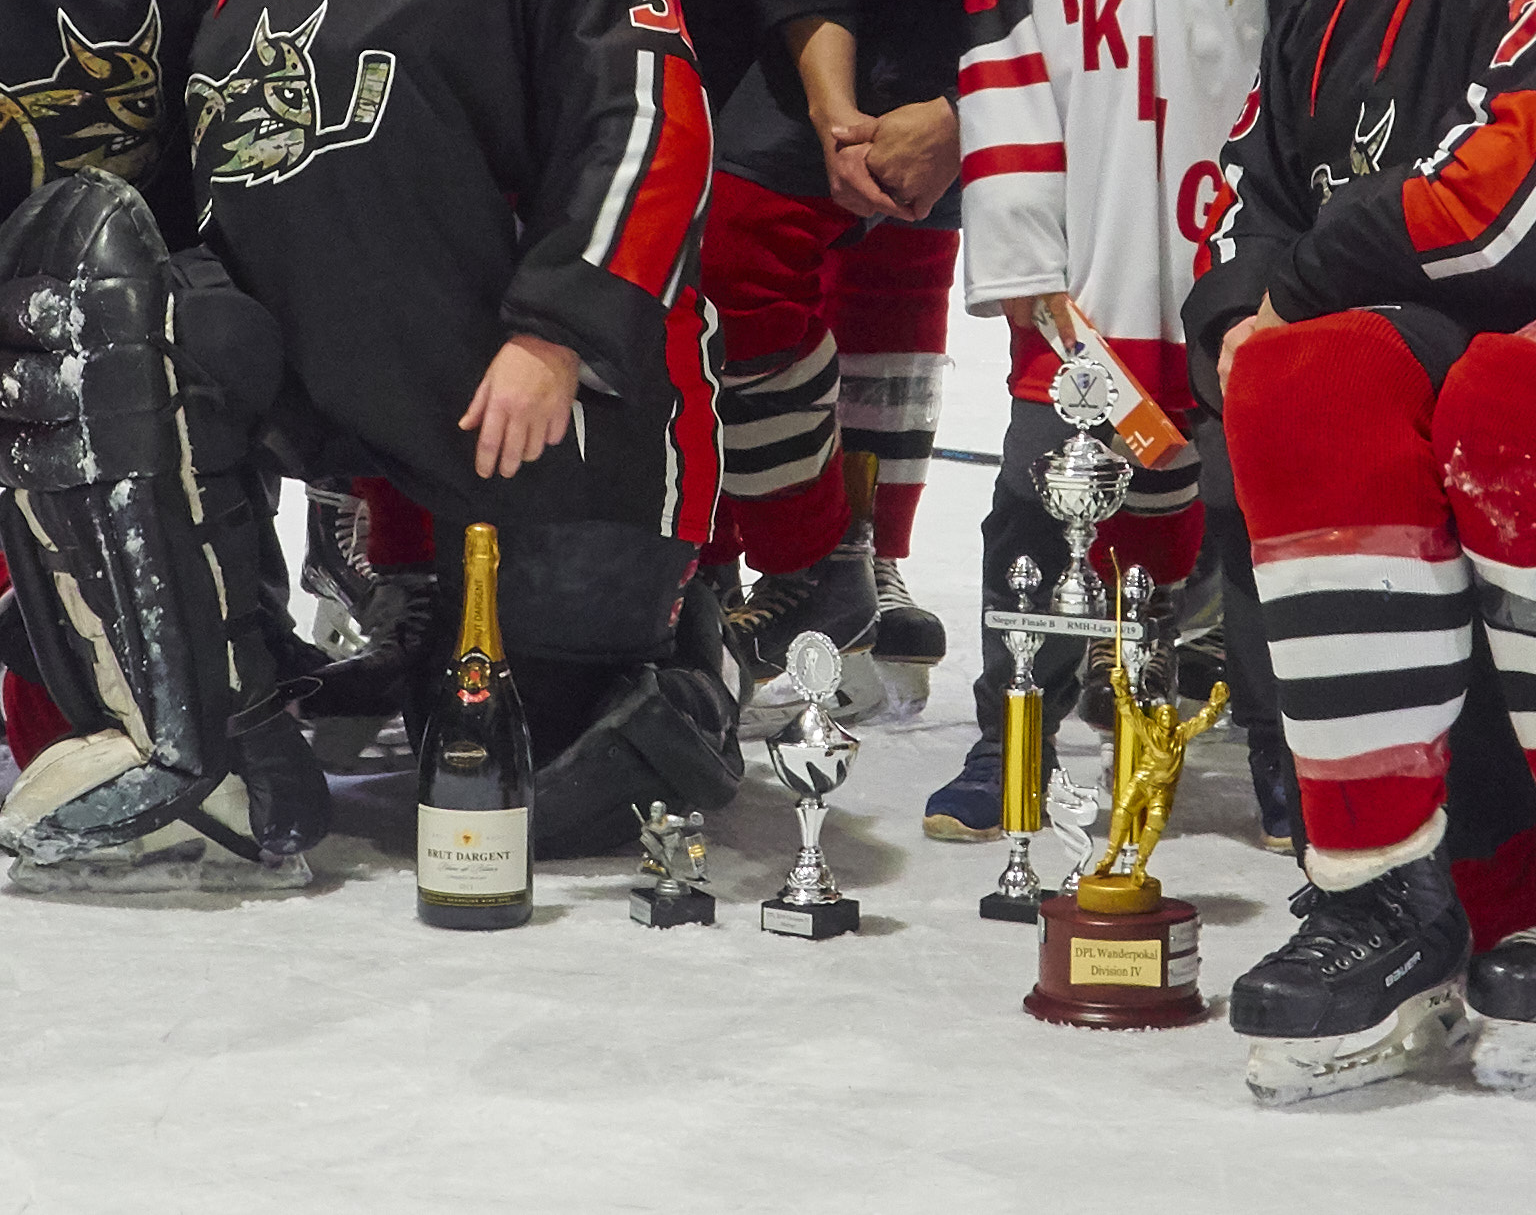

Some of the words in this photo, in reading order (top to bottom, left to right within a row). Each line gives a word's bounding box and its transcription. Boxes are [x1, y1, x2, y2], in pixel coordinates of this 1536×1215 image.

[427, 848, 453, 860] BRUT
[456, 850, 512, 862] DARGENT
[1075, 947, 1096, 959] DPL
[1097, 948, 1158, 963] Wanderpokal
[1091, 965, 1128, 977] Division
[1130, 966, 1142, 977] IV
